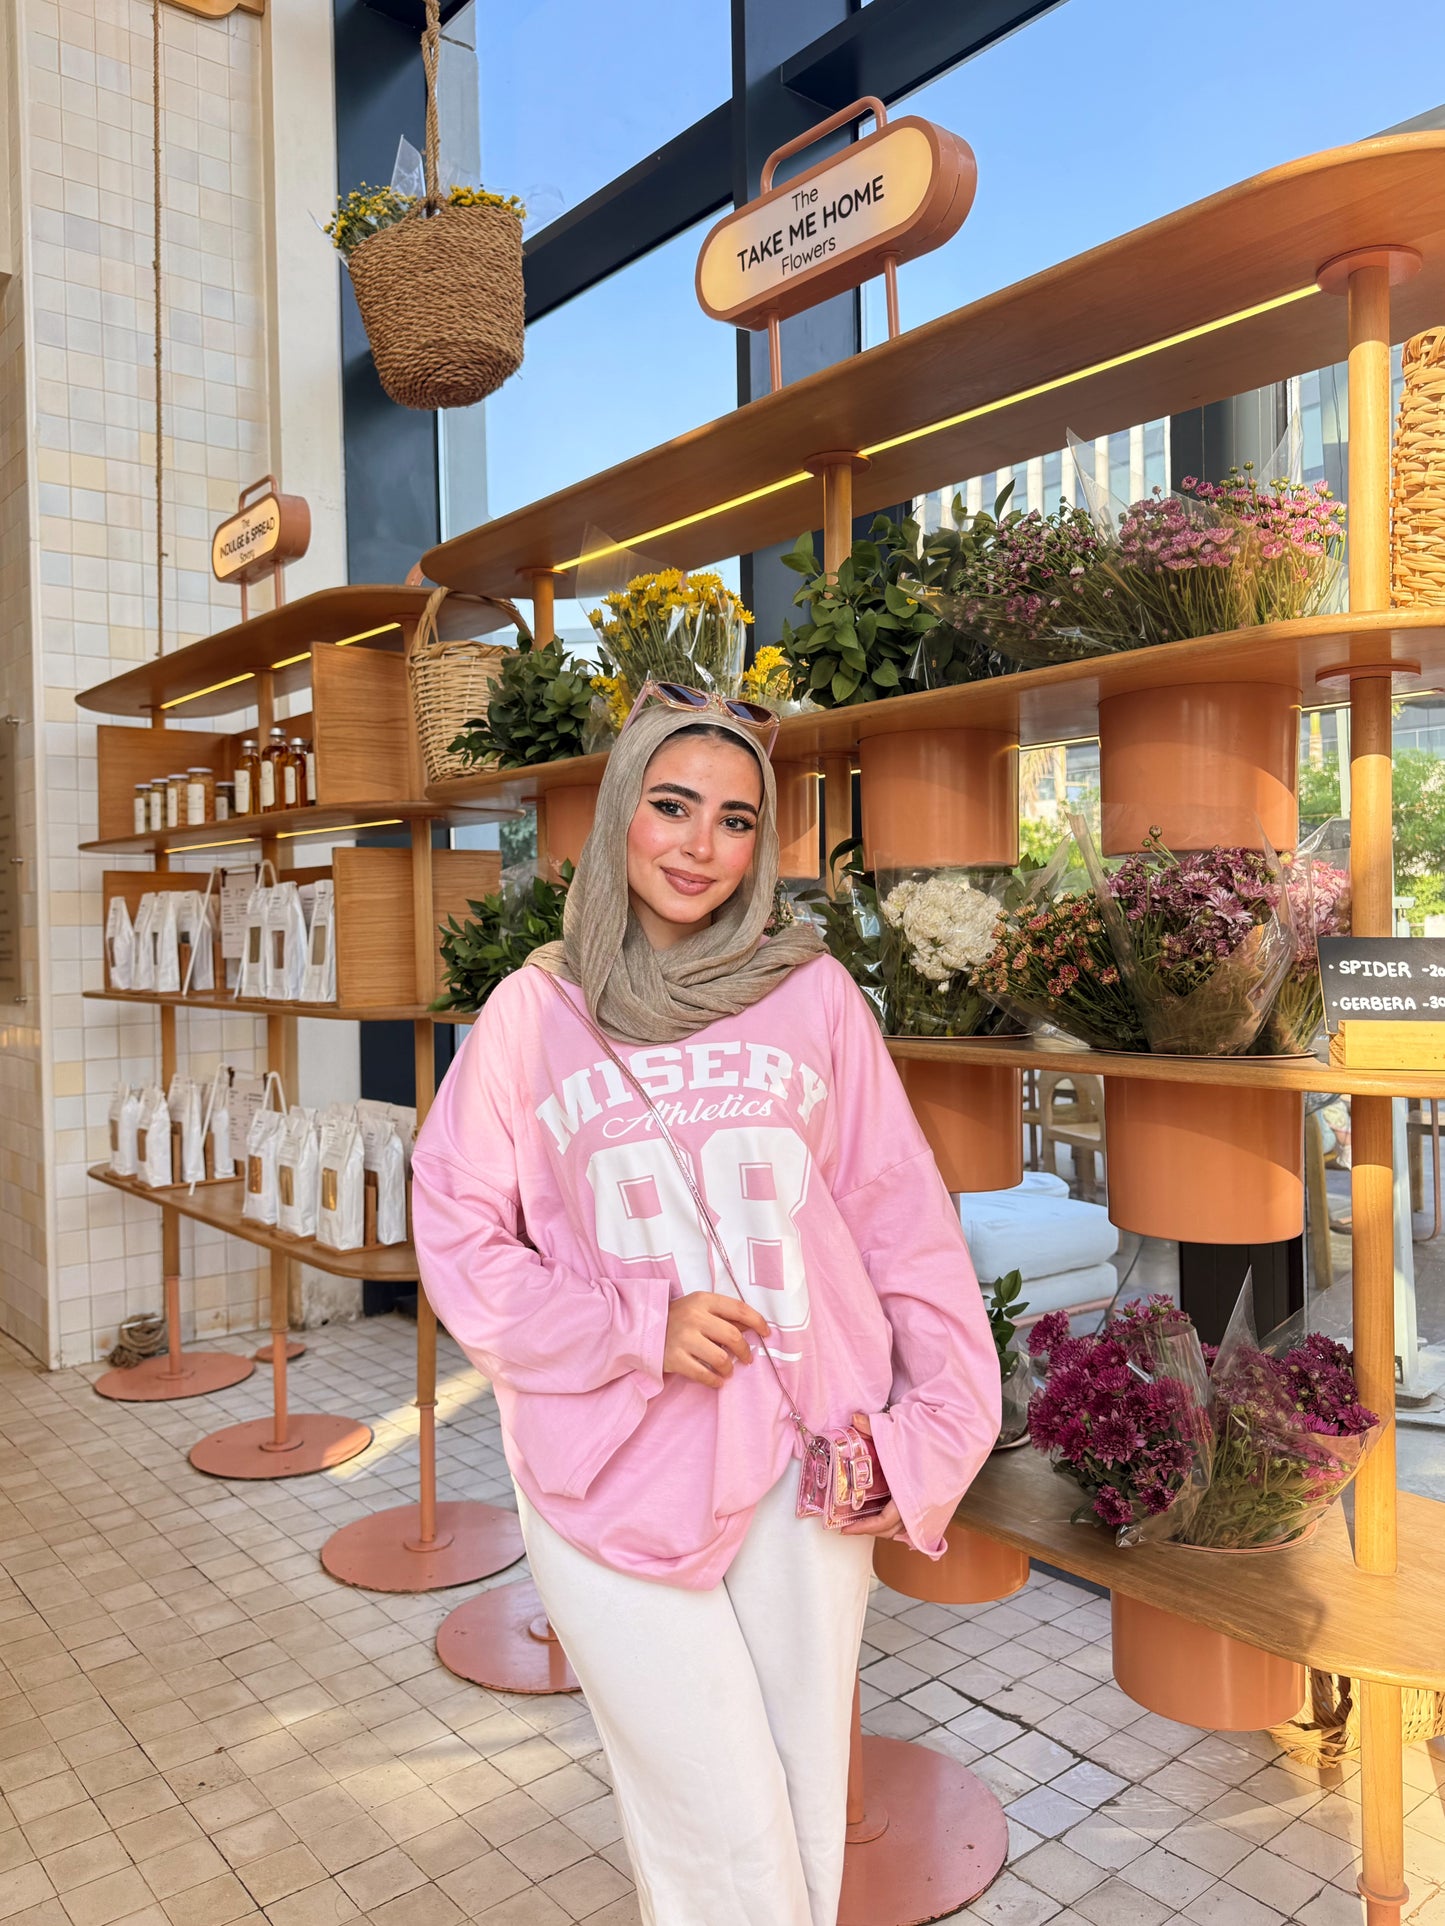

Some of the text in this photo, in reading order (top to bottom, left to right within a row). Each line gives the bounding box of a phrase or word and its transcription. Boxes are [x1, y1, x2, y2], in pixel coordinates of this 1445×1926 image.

[791, 186, 819, 212] The
[736, 175, 885, 272] TAKE ME HOME
[781, 236, 836, 275] Flowers
[1339, 960, 1412, 978] SPIDER
[1340, 996, 1417, 1011] GERBERA
[535, 1041, 828, 1155] MISERY
[602, 1093, 773, 1138] Athletics
[585, 1126, 811, 1331] 98
